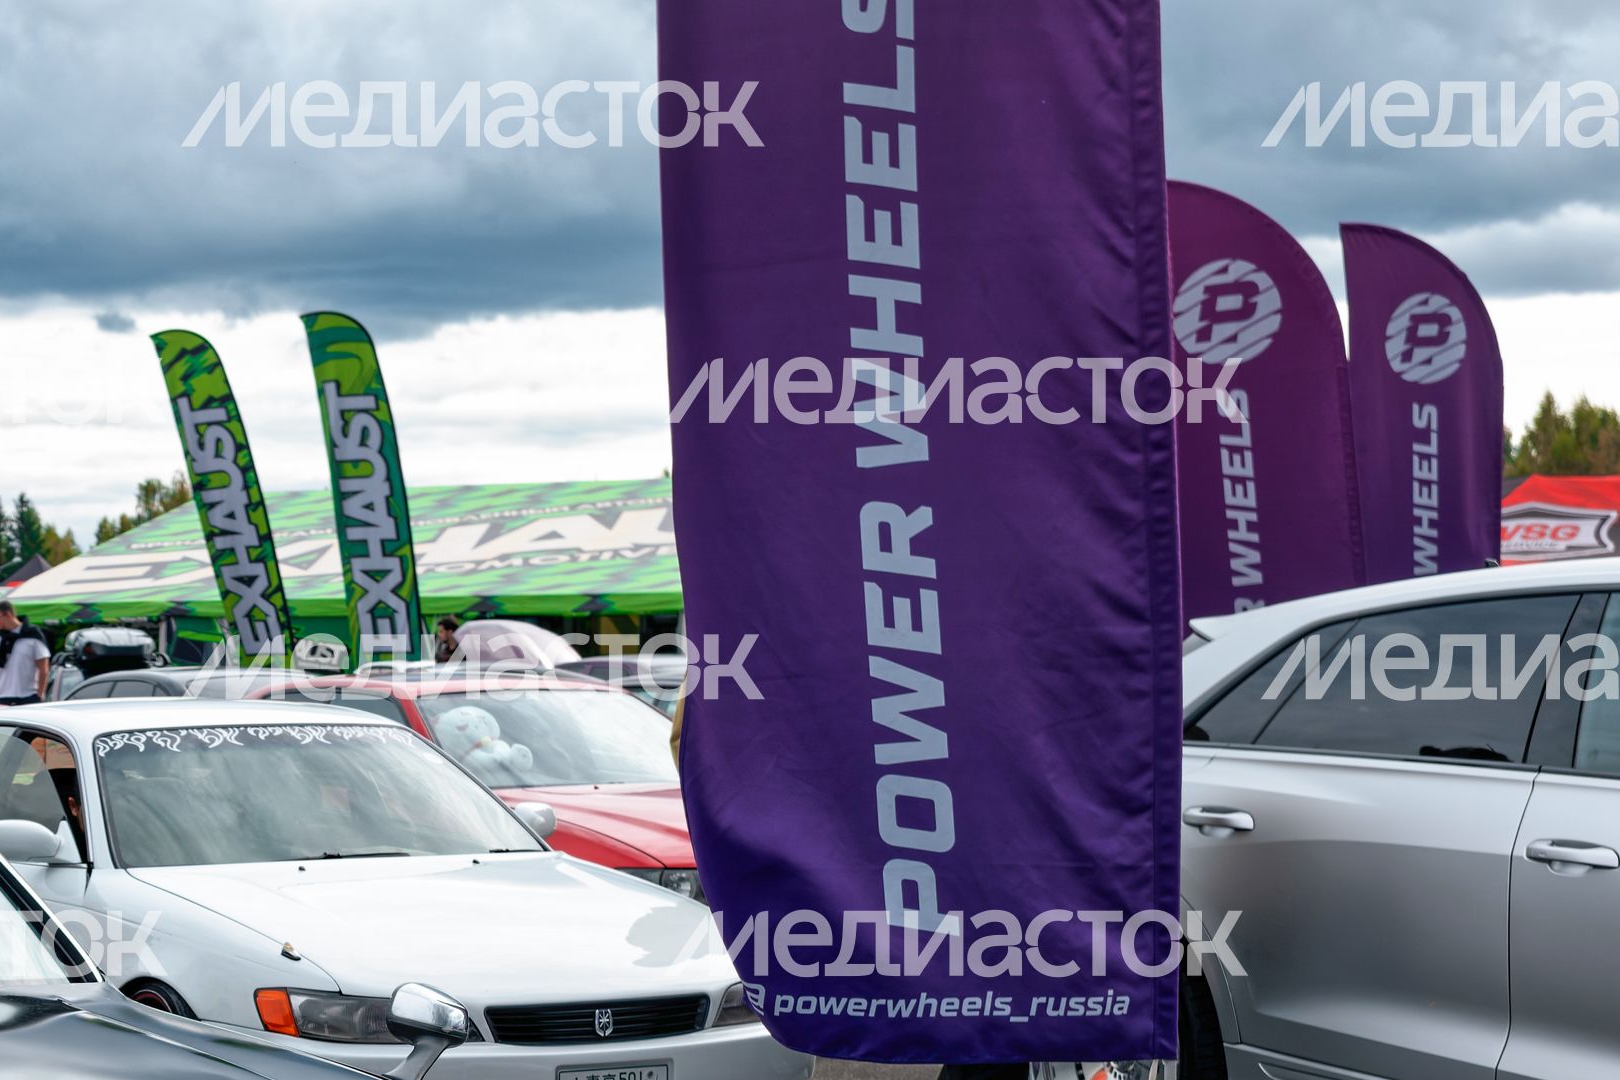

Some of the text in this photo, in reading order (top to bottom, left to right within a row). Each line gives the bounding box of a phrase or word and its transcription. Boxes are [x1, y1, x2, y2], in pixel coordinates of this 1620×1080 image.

[175, 395, 286, 656] EXHAUST
[323, 380, 413, 655] EXHAUST
[841, 0, 960, 938] POWER WHEELS
[1215, 388, 1264, 588] WHEELS
[1411, 402, 1439, 577] WHEELS
